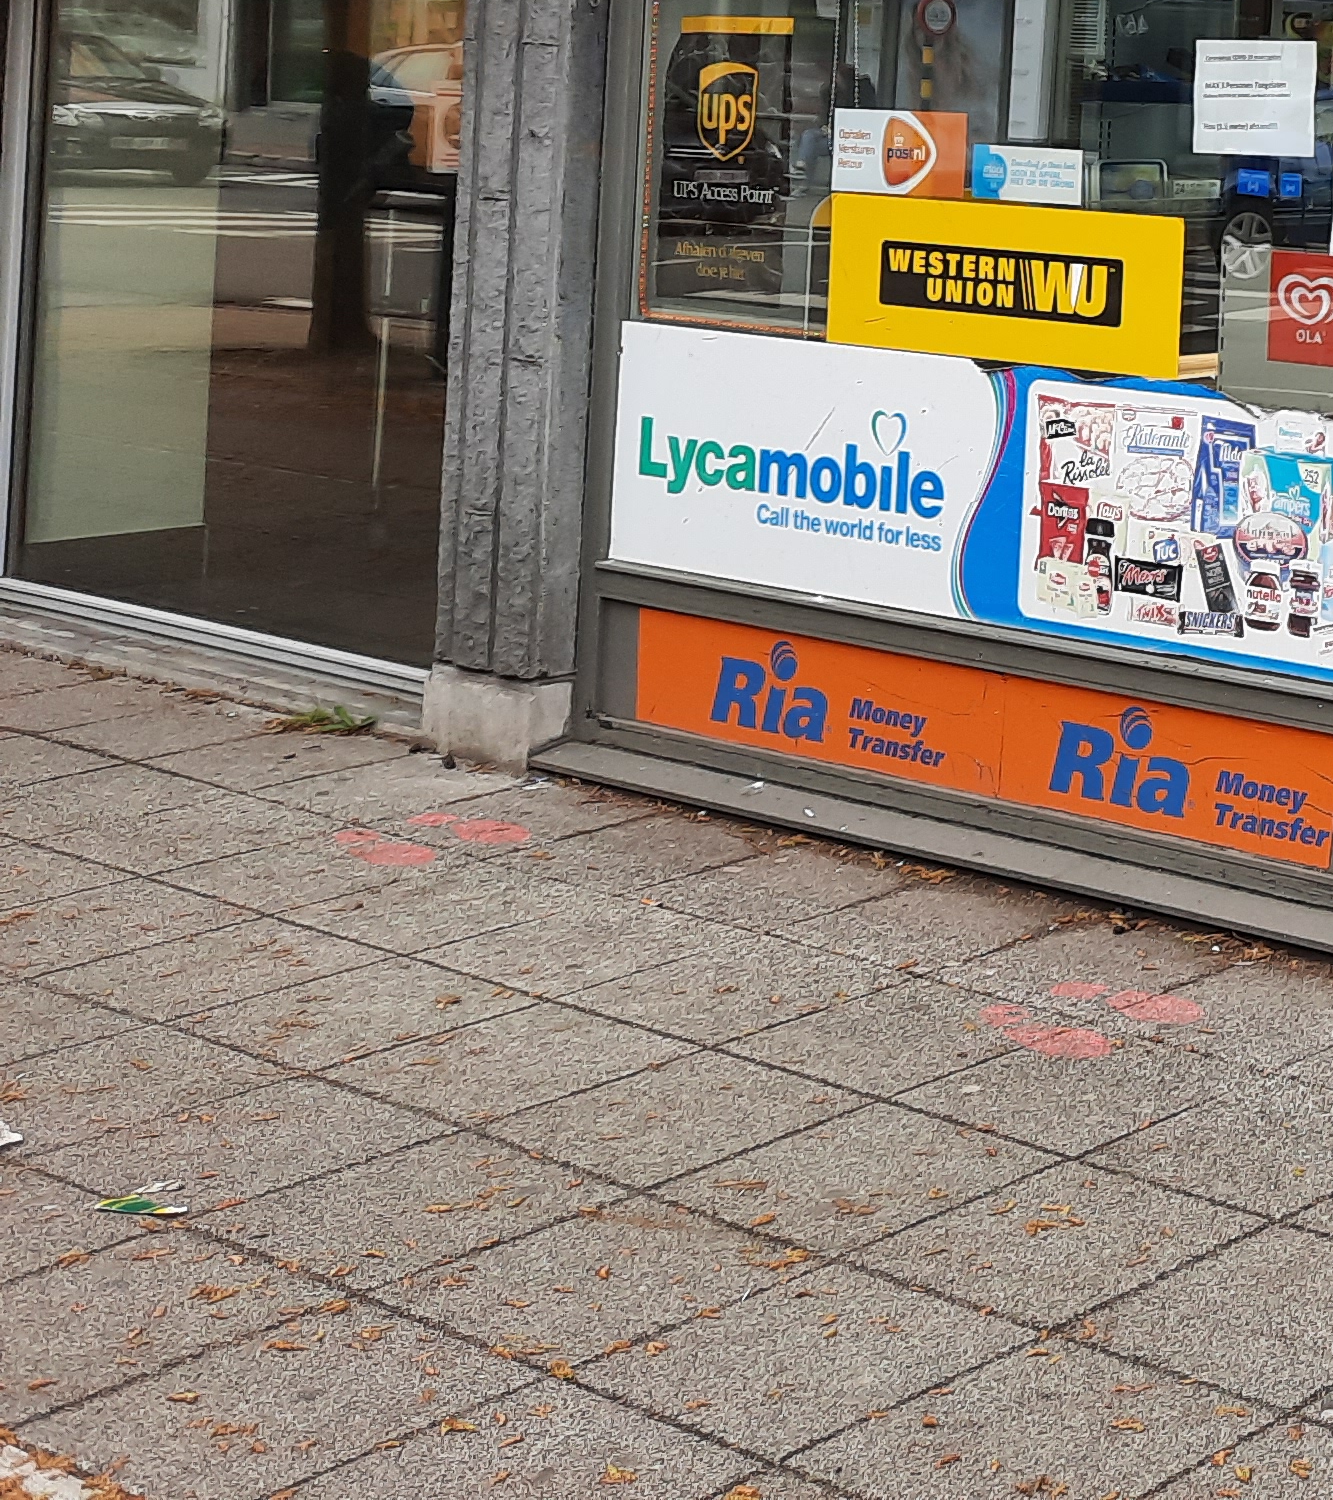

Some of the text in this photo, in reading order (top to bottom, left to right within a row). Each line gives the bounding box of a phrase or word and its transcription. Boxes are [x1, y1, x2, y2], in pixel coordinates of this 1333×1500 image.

[702, 93, 752, 144] ups
[887, 146, 925, 163] postnl
[674, 181, 698, 198] UPS
[700, 183, 738, 201] Access
[889, 248, 1015, 282] WESTERN
[926, 278, 1014, 308] UNION
[1031, 259, 1108, 317] WU
[1296, 330, 1322, 344] OLA
[1123, 424, 1190, 448] Ristorante
[639, 417, 945, 519] Lycamobile
[756, 503, 941, 552] Call the world for less
[1155, 542, 1176, 559] TUC
[1247, 589, 1281, 602] nutella
[1185, 613, 1234, 629] SNICKERS
[710, 641, 828, 743] Ria
[849, 697, 927, 737] Money
[848, 727, 946, 770] Transfer
[1049, 706, 1191, 818] Ria
[1215, 771, 1308, 814] Money
[1214, 803, 1330, 849] Transfer
